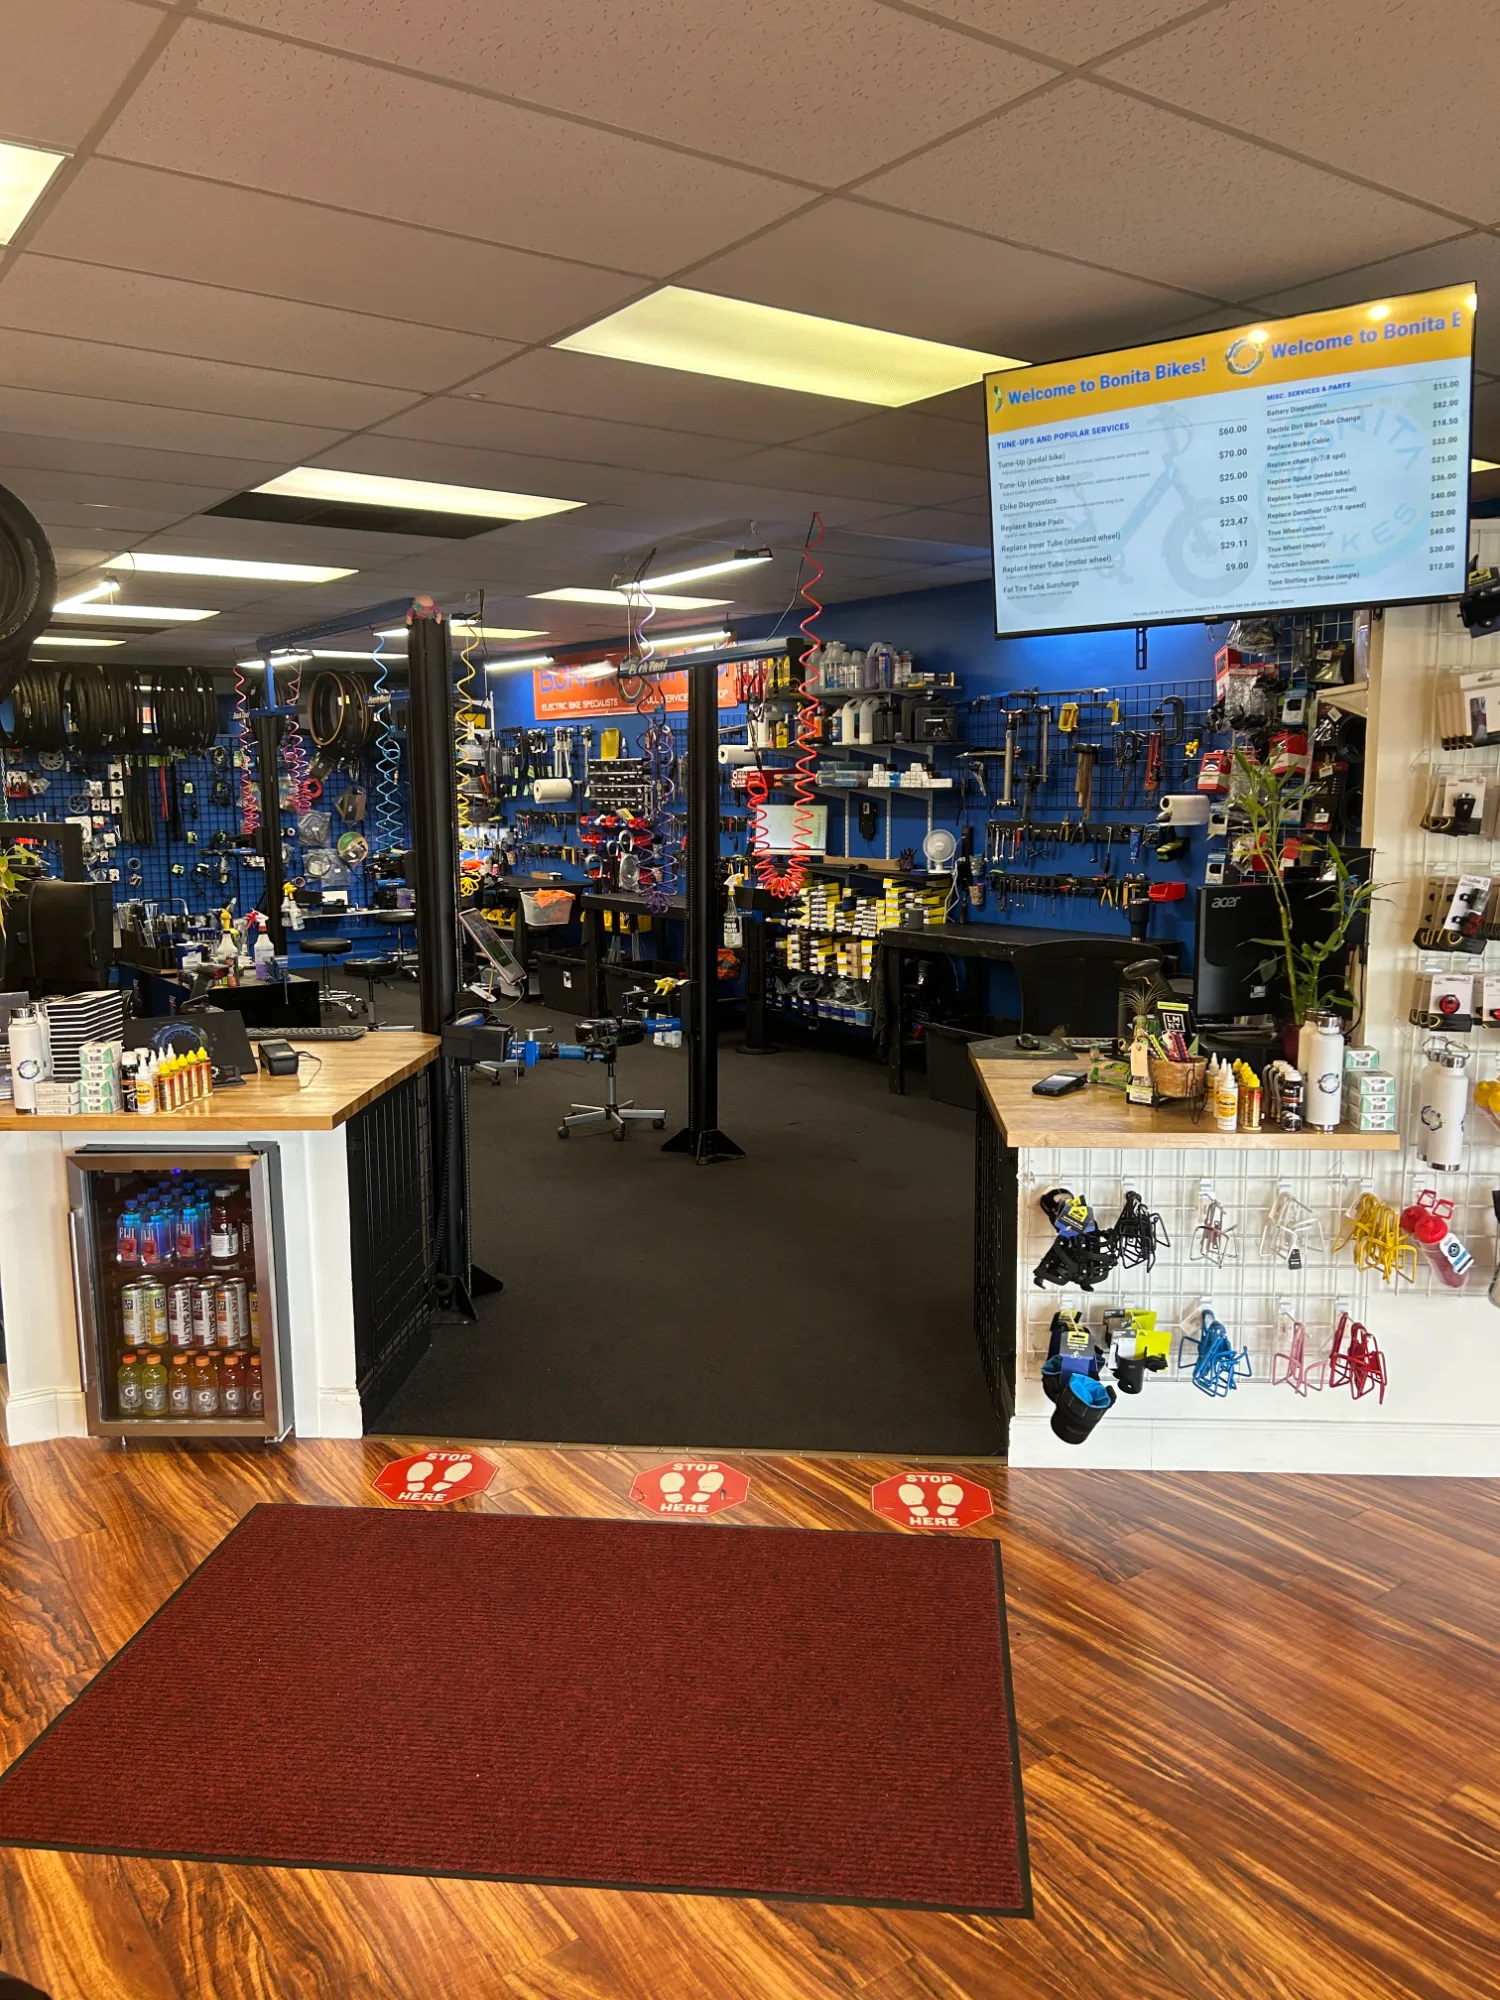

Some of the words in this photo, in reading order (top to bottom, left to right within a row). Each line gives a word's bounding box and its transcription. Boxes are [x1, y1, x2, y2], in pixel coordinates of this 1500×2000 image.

[1272, 333, 1354, 359] Welcome
[1360, 329, 1378, 344] to
[1383, 317, 1445, 340] Bonita
[1008, 384, 1076, 405] Welcome
[1080, 380, 1095, 393] to
[1100, 370, 1151, 389] Bonita
[1155, 357, 1206, 380] Bikes!
[1433, 380, 1459, 391] $15.00
[1287, 386, 1320, 398] SERVICES
[1328, 381, 1351, 391] PARTS
[1267, 407, 1290, 417] Battery
[1290, 402, 1327, 414] Diagnostics
[1218, 424, 1248, 436] $60.00
[1267, 425, 1290, 434] Electric
[1291, 423, 1303, 431] Dirt
[1304, 421, 1318, 429] Bike
[1319, 418, 1335, 426] Tube
[1336, 415, 1361, 425] Change
[997, 437, 1035, 450] TUNE-UPS
[1036, 434, 1052, 444] AND
[1054, 428, 1090, 441] POPULAR
[1092, 422, 1130, 435] SERVICES
[1267, 442, 1291, 452] Replace
[1311, 436, 1330, 445] Cable
[1218, 448, 1248, 460] $70.00
[1267, 460, 1291, 469] Replace
[1332, 451, 1346, 460] spd)
[1431, 454, 1457, 464] $21.00
[998, 457, 1026, 469] Tune-Up
[1027, 455, 1048, 466] (pedal
[1048, 452, 1066, 462] bike)
[999, 479, 1027, 490] Tune-Up
[1028, 476, 1055, 487] (electric
[1056, 473, 1071, 481] bike
[1219, 471, 1248, 482] $25.00
[1267, 477, 1291, 486] Replace
[1292, 474, 1312, 483] Spoke
[1313, 471, 1333, 480] (pedal
[1334, 468, 1350, 477] bike)
[1431, 472, 1457, 482] $36.00
[1219, 494, 1248, 505] $35.00
[1267, 494, 1291, 503] Replace
[1292, 491, 1312, 500] Spoke
[1313, 489, 1334, 498] (motor
[1336, 485, 1357, 494] wheel)
[1431, 491, 1456, 500] $40.00
[999, 502, 1018, 512] Ebike
[1018, 498, 1057, 509] Diagnostics
[1267, 511, 1292, 520] Replace
[1344, 502, 1366, 512] speed)
[1430, 509, 1456, 518] $20.00
[1000, 523, 1027, 533] Replace
[1028, 520, 1047, 528] Brake
[1048, 518, 1065, 526] Pads
[1220, 517, 1248, 528] $23.47
[1267, 529, 1281, 537] True
[1282, 525, 1302, 534] Wheel
[1302, 524, 1325, 534] (minor)
[1430, 527, 1455, 536] $40.00
[1001, 544, 1028, 554] Replace
[1028, 541, 1045, 550] Inner
[1047, 539, 1063, 547] Tube
[1064, 534, 1097, 547] (standard
[1098, 531, 1121, 541] wheel)
[1220, 540, 1248, 550] $29.11
[1282, 543, 1302, 551] Wheel
[1302, 541, 1325, 551] (major)
[1002, 564, 1029, 575] Replace
[1029, 562, 1046, 570] Inner
[1047, 560, 1064, 568] Tube
[1065, 557, 1088, 567] (motor
[1089, 554, 1112, 564] wheel)
[1225, 561, 1249, 571] $9.00
[1300, 558, 1330, 567] Drivetrain
[1429, 562, 1454, 571] $12.00
[1335, 571, 1360, 581] (single)
[1003, 586, 1014, 594] Fat
[1015, 584, 1027, 592] Tire
[1029, 582, 1045, 591] Tube
[1046, 580, 1080, 590] Surcharge
[541, 702, 568, 711] ELECTRIC
[568, 700, 581, 709] BIKE
[582, 697, 618, 708] SPECIALISTS
[1211, 896, 1242, 908] acer
[1166, 1015, 1180, 1023] LM
[119, 1226, 136, 1239] FIJI
[140, 1229, 155, 1241] FIJI
[177, 1223, 191, 1235] FIJI
[182, 1290, 190, 1312] STAY
[183, 1314, 191, 1341] SALTY
[125, 1387, 135, 1397] G
[145, 1389, 153, 1399] G
[172, 1390, 182, 1400] G
[199, 1391, 210, 1401] G
[225, 1390, 236, 1400] G
[426, 1452, 472, 1462] STOP
[672, 1463, 719, 1471] STOP
[906, 1474, 953, 1483] STOP
[398, 1491, 447, 1501] HERE
[660, 1503, 709, 1513] HERE
[909, 1516, 960, 1527] HERE
